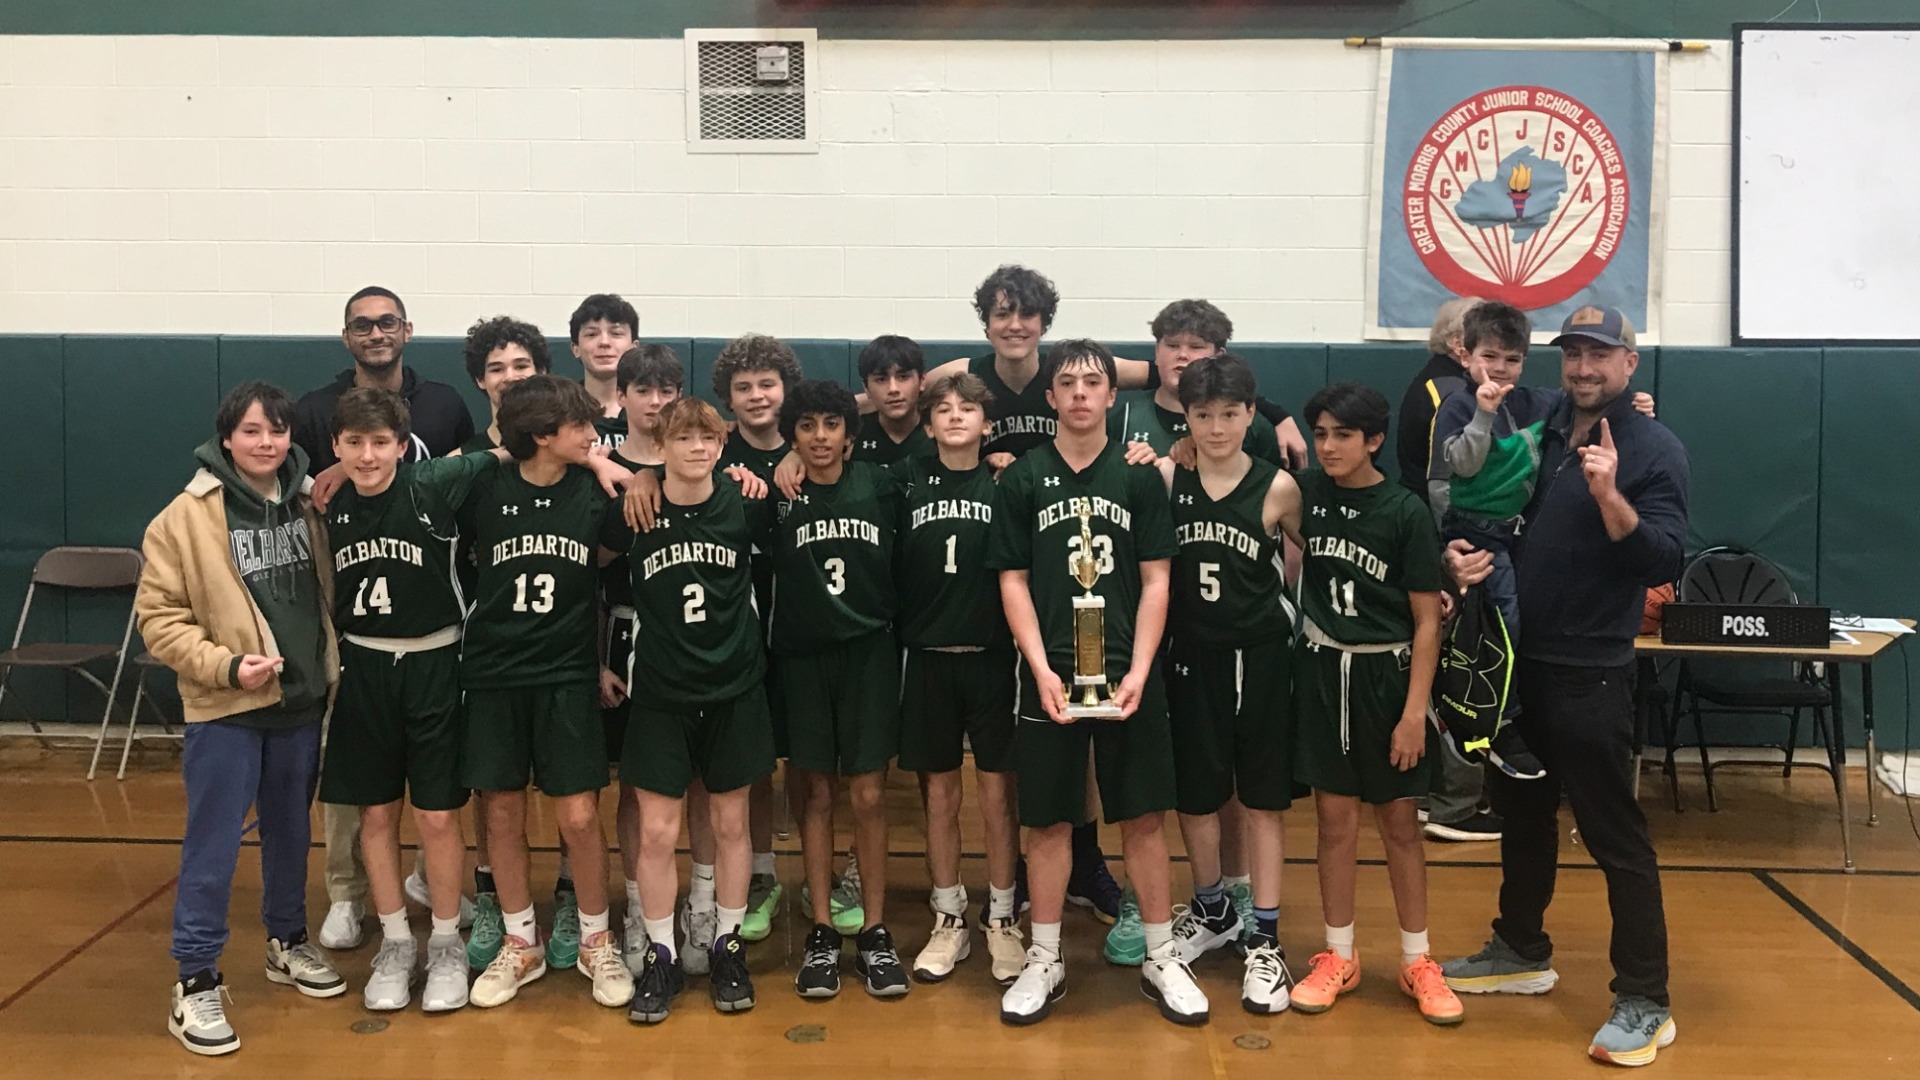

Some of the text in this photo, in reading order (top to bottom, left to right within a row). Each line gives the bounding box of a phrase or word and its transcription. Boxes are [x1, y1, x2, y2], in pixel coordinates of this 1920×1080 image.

[1408, 90, 1625, 260] GREATER MORRIS COUNTY JUNIOR SCHOOL COACHES ASSOCIATION
[1440, 119, 1593, 203] G M C J S C A
[984, 415, 1059, 446] ELBARTO
[911, 499, 992, 530] DELBARTO
[229, 518, 313, 576] ELBARTO
[335, 537, 423, 572] DELBARTON
[492, 534, 589, 567] DELBARTON
[643, 541, 737, 580] DELBARTON
[944, 534, 957, 573] 1
[1067, 534, 1114, 575] 23
[1175, 521, 1260, 561] ELBARTON
[1308, 536, 1388, 582] ELBARTON
[353, 576, 391, 616] 14
[513, 573, 555, 613] 13
[824, 557, 845, 595] 3
[1200, 562, 1220, 602] 5
[682, 583, 706, 623] 2
[1329, 576, 1358, 617] 11
[1722, 615, 1769, 637] POSS.
